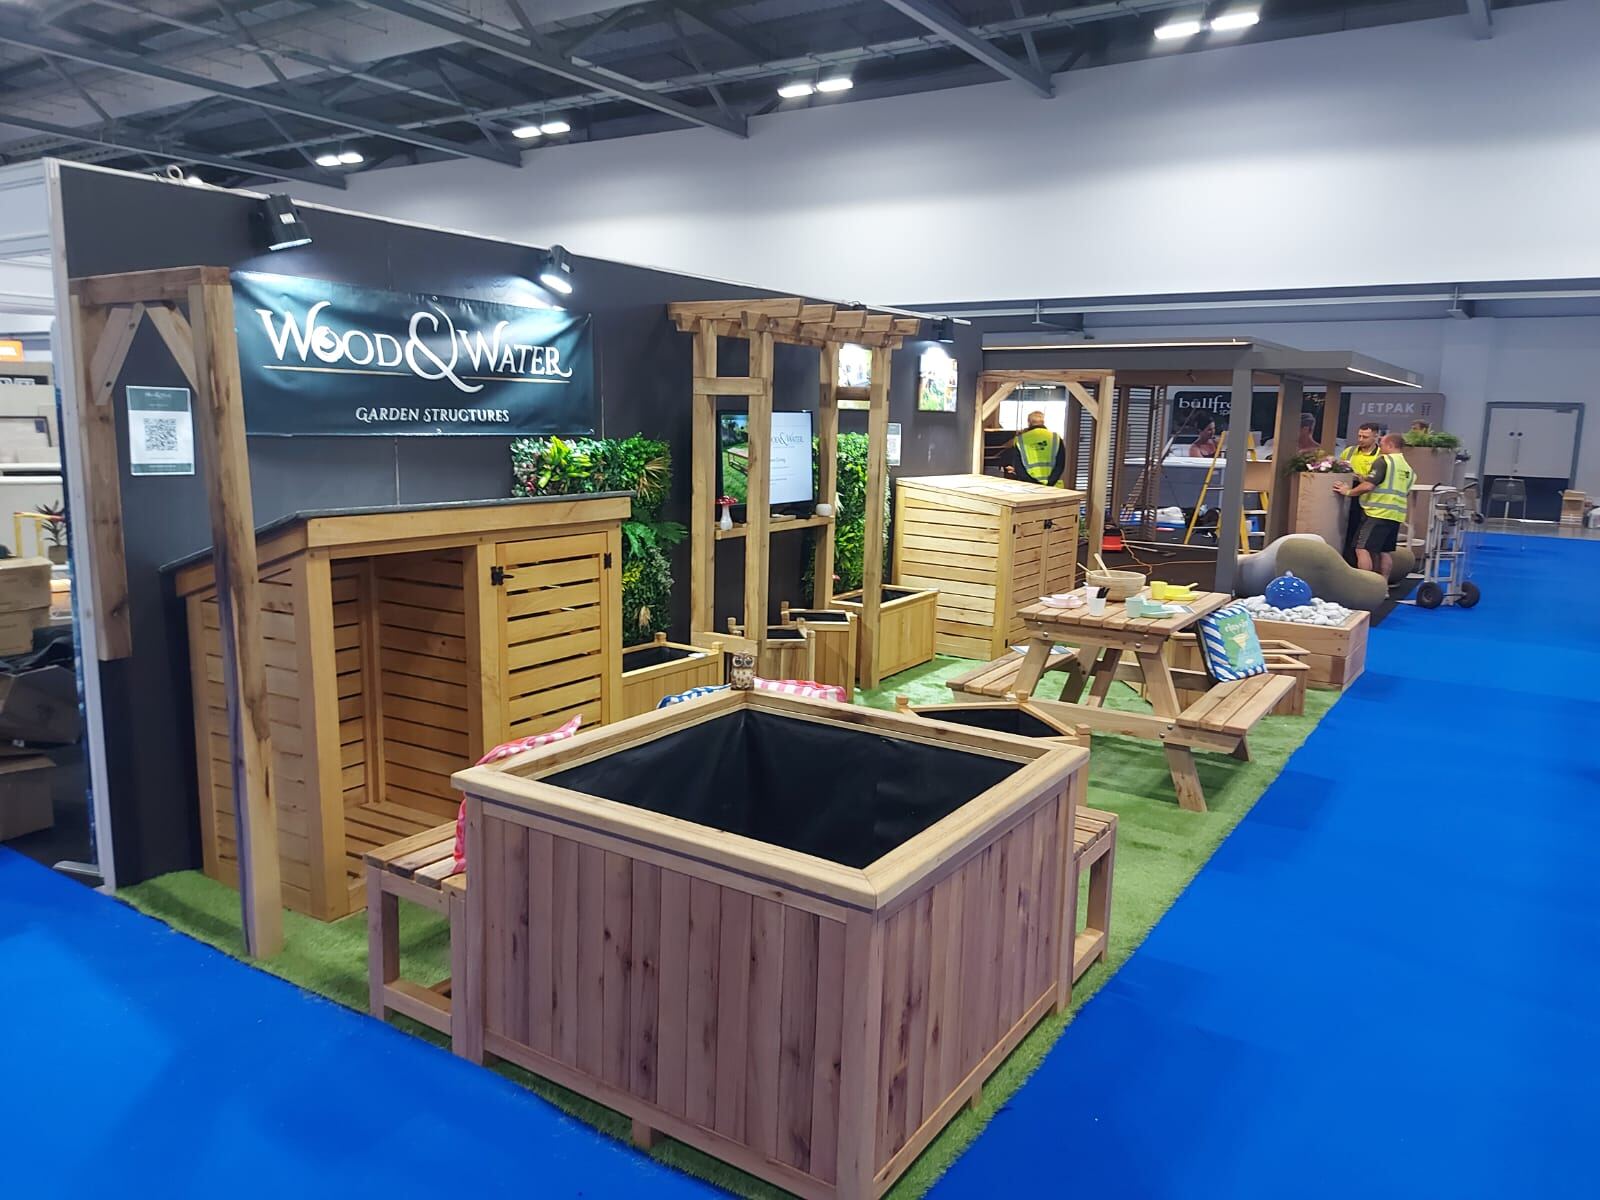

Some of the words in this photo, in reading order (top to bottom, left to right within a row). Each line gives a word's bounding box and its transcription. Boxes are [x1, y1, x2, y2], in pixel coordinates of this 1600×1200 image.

[1179, 395, 1232, 413] bullfro
[1359, 402, 1415, 415] JETPAK
[355, 406, 420, 423] GARDEN
[423, 407, 510, 424] STRUCTURES
